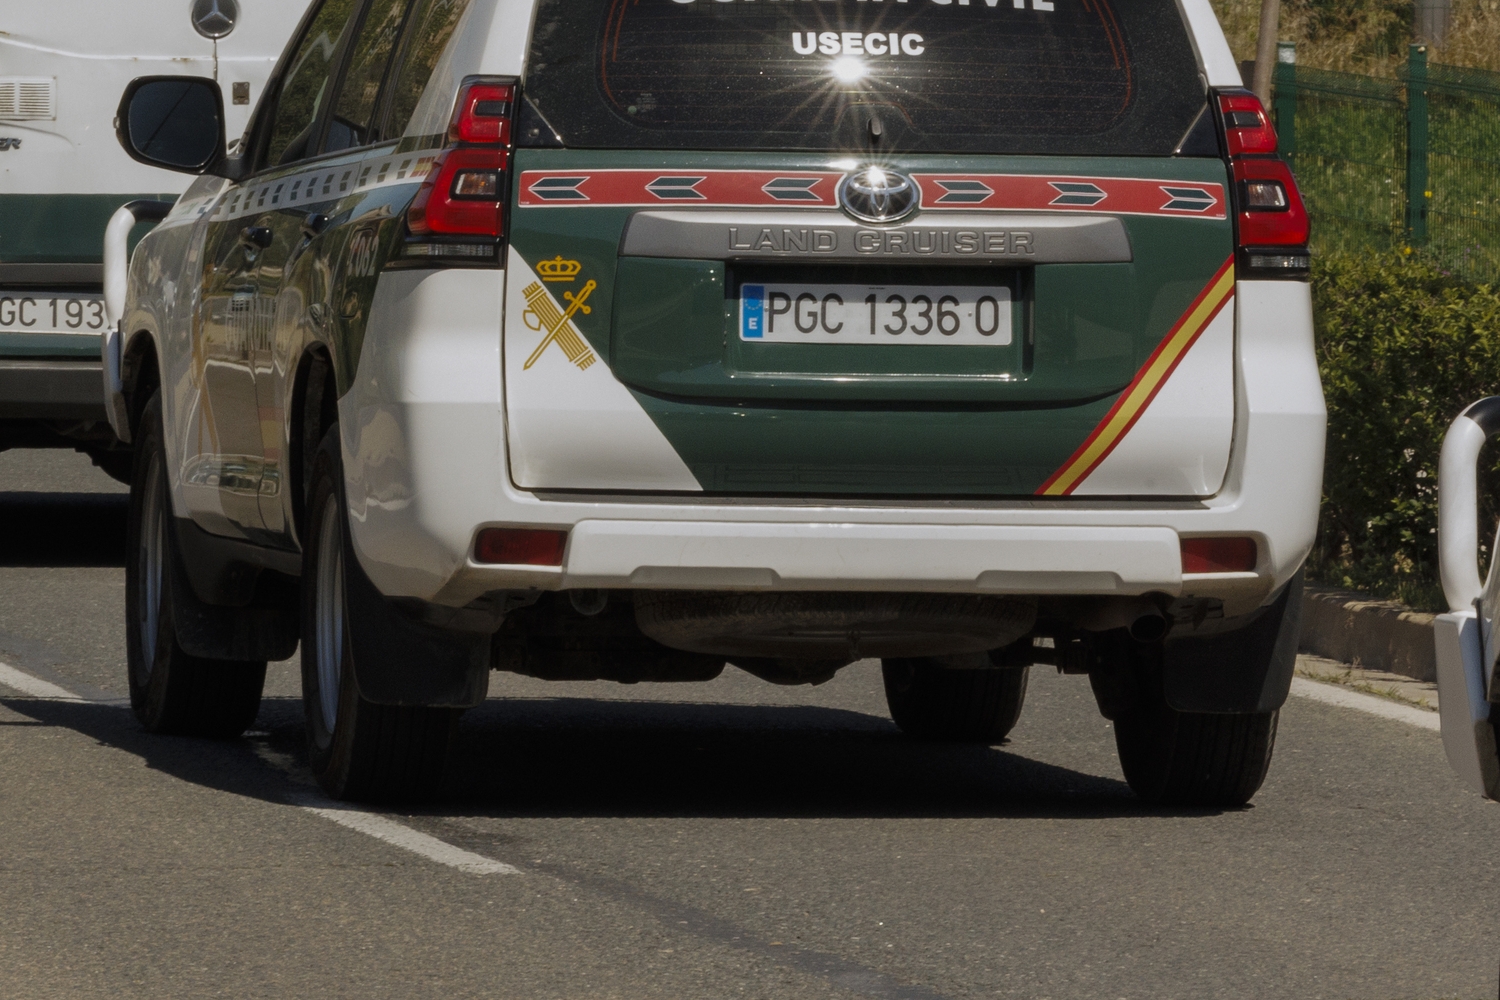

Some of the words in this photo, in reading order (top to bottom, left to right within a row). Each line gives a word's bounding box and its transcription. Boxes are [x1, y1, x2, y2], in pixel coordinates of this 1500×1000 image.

[791, 31, 925, 56] USECIC
[728, 227, 839, 254] LAND
[853, 229, 1036, 256] CRUISER
[49, 297, 105, 330] 193
[749, 317, 758, 330] E
[767, 291, 845, 334] PGC
[864, 293, 961, 337] 1336
